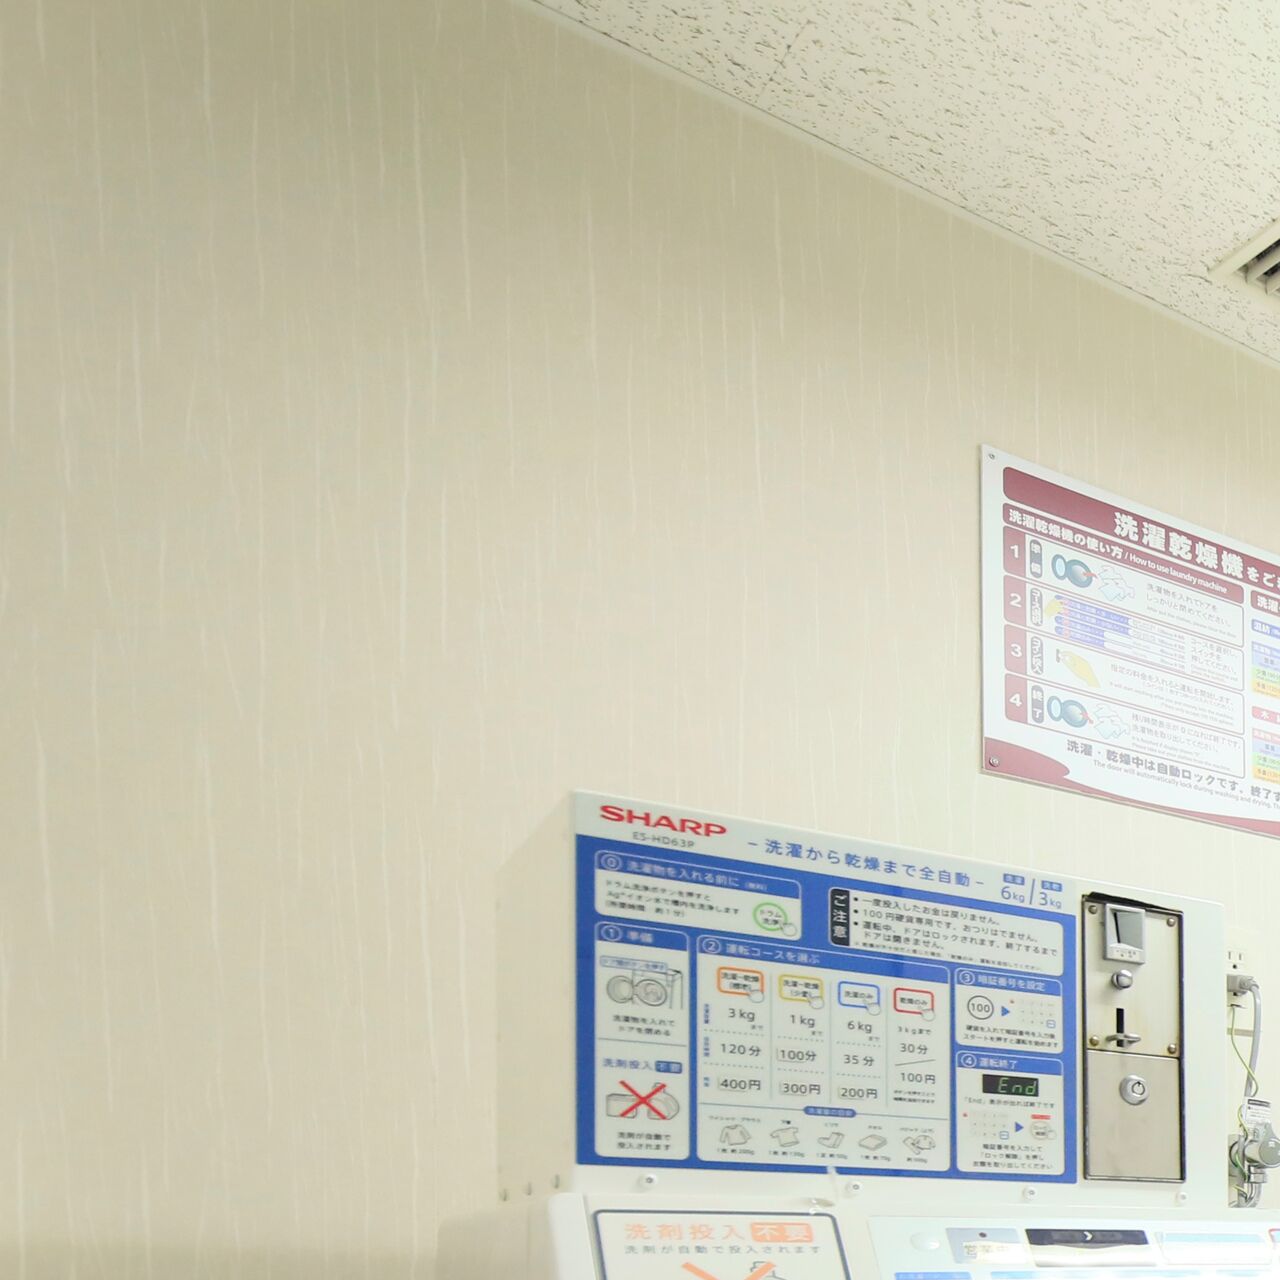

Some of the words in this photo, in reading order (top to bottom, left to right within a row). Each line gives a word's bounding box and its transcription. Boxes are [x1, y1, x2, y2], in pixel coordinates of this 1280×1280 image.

[1130, 552, 1146, 568] How
[1156, 564, 1169, 575] use
[1170, 566, 1197, 586] laundry
[1198, 576, 1228, 595] machine
[1009, 693, 1023, 707] 4
[600, 804, 727, 837] SHARP
[632, 831, 695, 849] ES-HD63P
[832, 893, 848, 939] ご注意
[862, 896, 1001, 925] 一度投入したお金は戻りません。
[864, 930, 946, 951] ドアは開きません。
[726, 942, 820, 965] 運転コースを選ぶ
[978, 974, 1046, 992] 暗証番号を設定
[971, 1003, 990, 1013] 100
[779, 1048, 817, 1062] 100分
[979, 1057, 1018, 1070] 運転終了
[720, 1077, 761, 1092] 400円
[782, 1081, 821, 1095] 300円
[840, 1086, 878, 1100] 200円
[900, 1071, 936, 1085] 100円
[998, 1077, 1037, 1096] End
[624, 1223, 745, 1241] 洗剤投入
[755, 1222, 811, 1241] 不要
[624, 1244, 821, 1255] 洗剤が自動で投入されます
